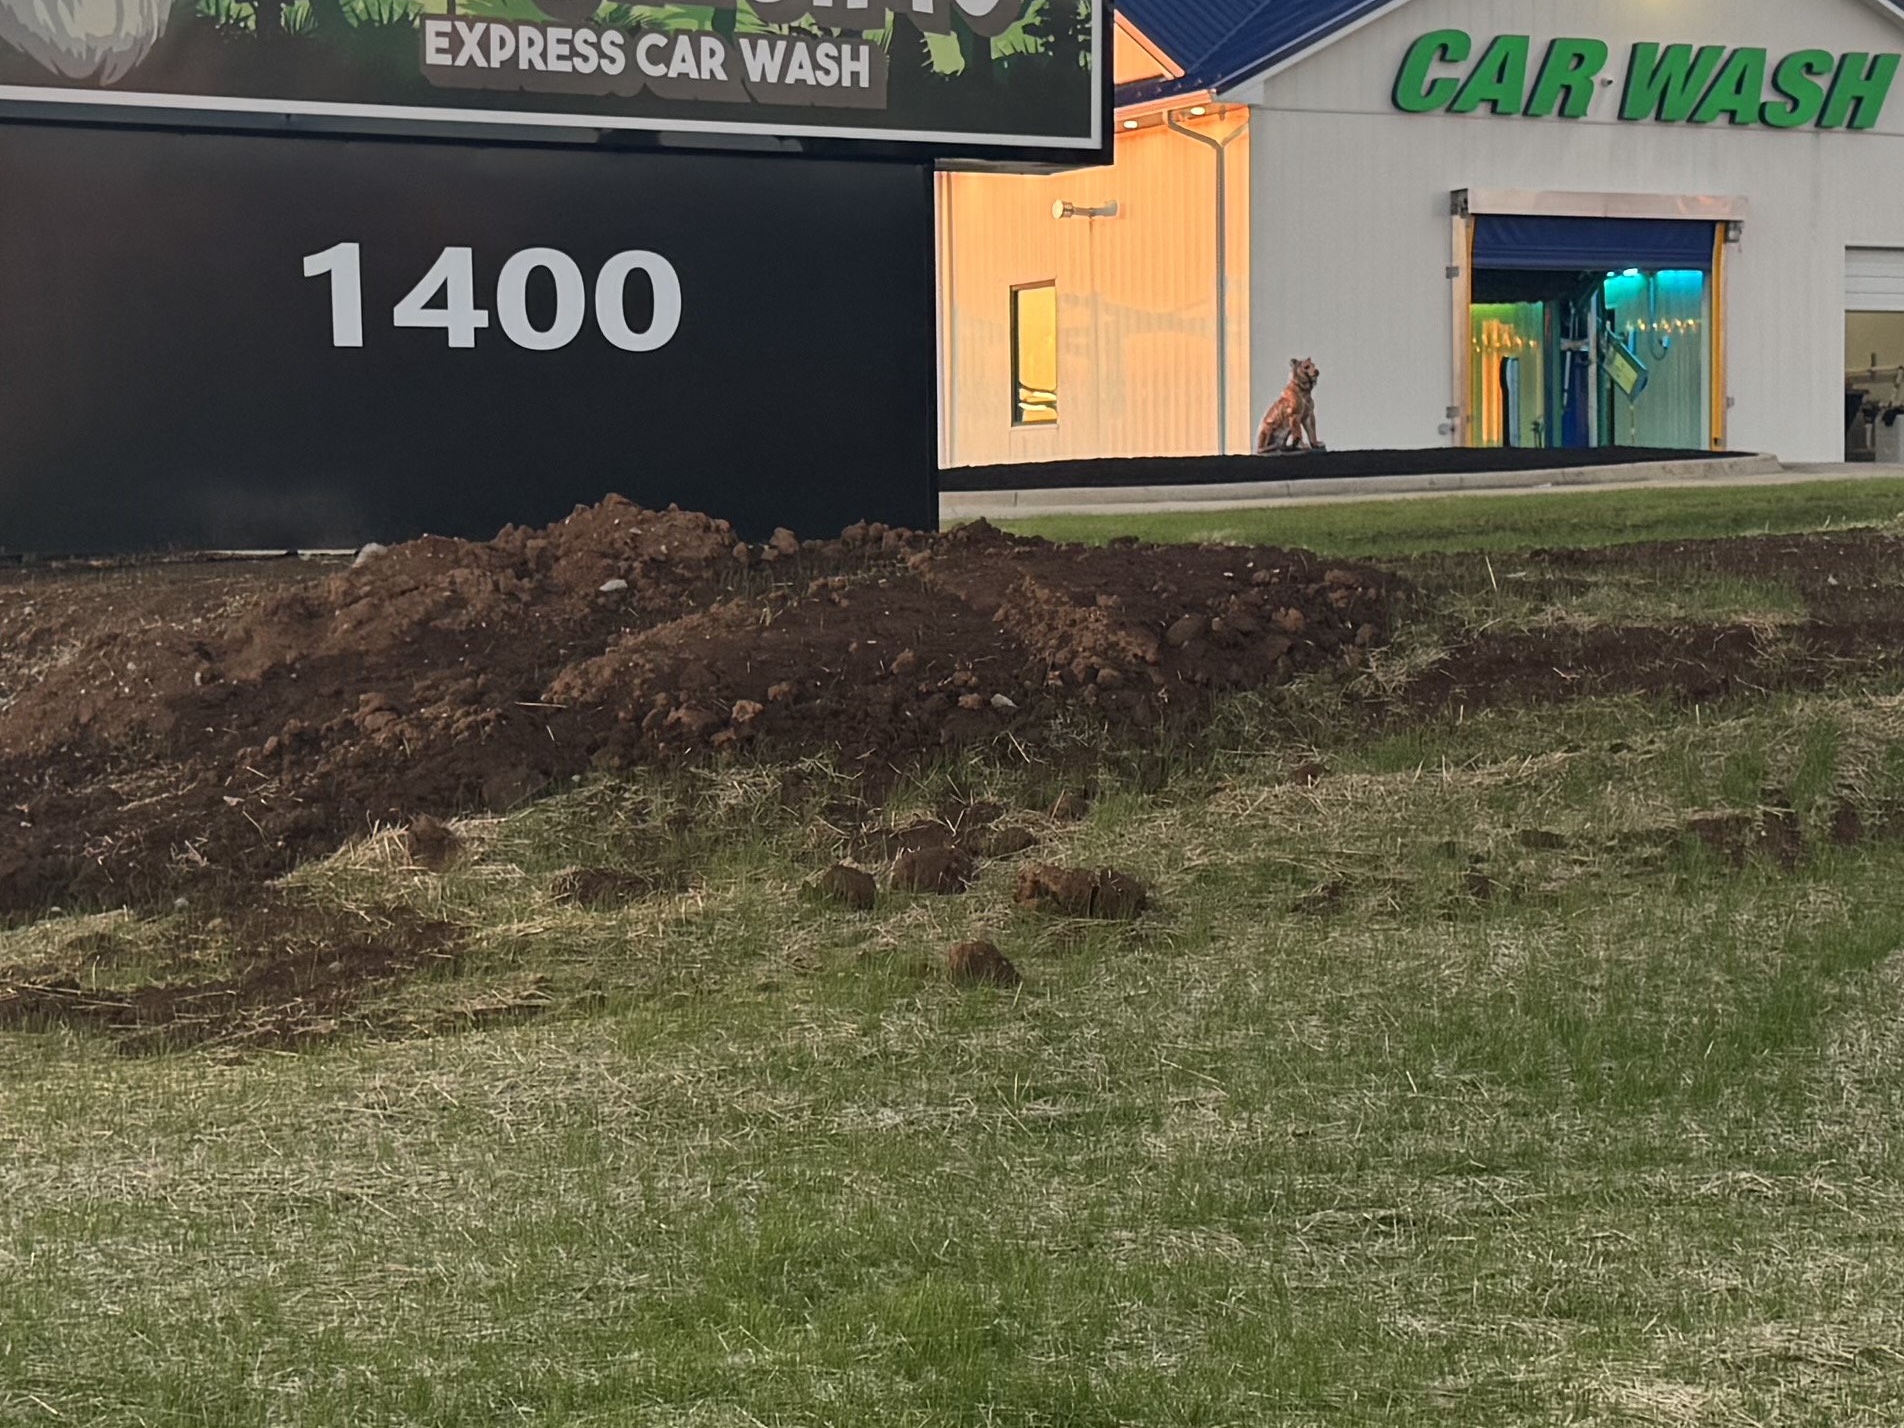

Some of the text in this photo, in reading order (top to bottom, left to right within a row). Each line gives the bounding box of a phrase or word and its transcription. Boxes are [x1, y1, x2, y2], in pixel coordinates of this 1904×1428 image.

[425, 19, 870, 88] EXPRESS CAR WASH
[1391, 29, 1902, 130] CAR WASH
[303, 242, 682, 352] 1400
